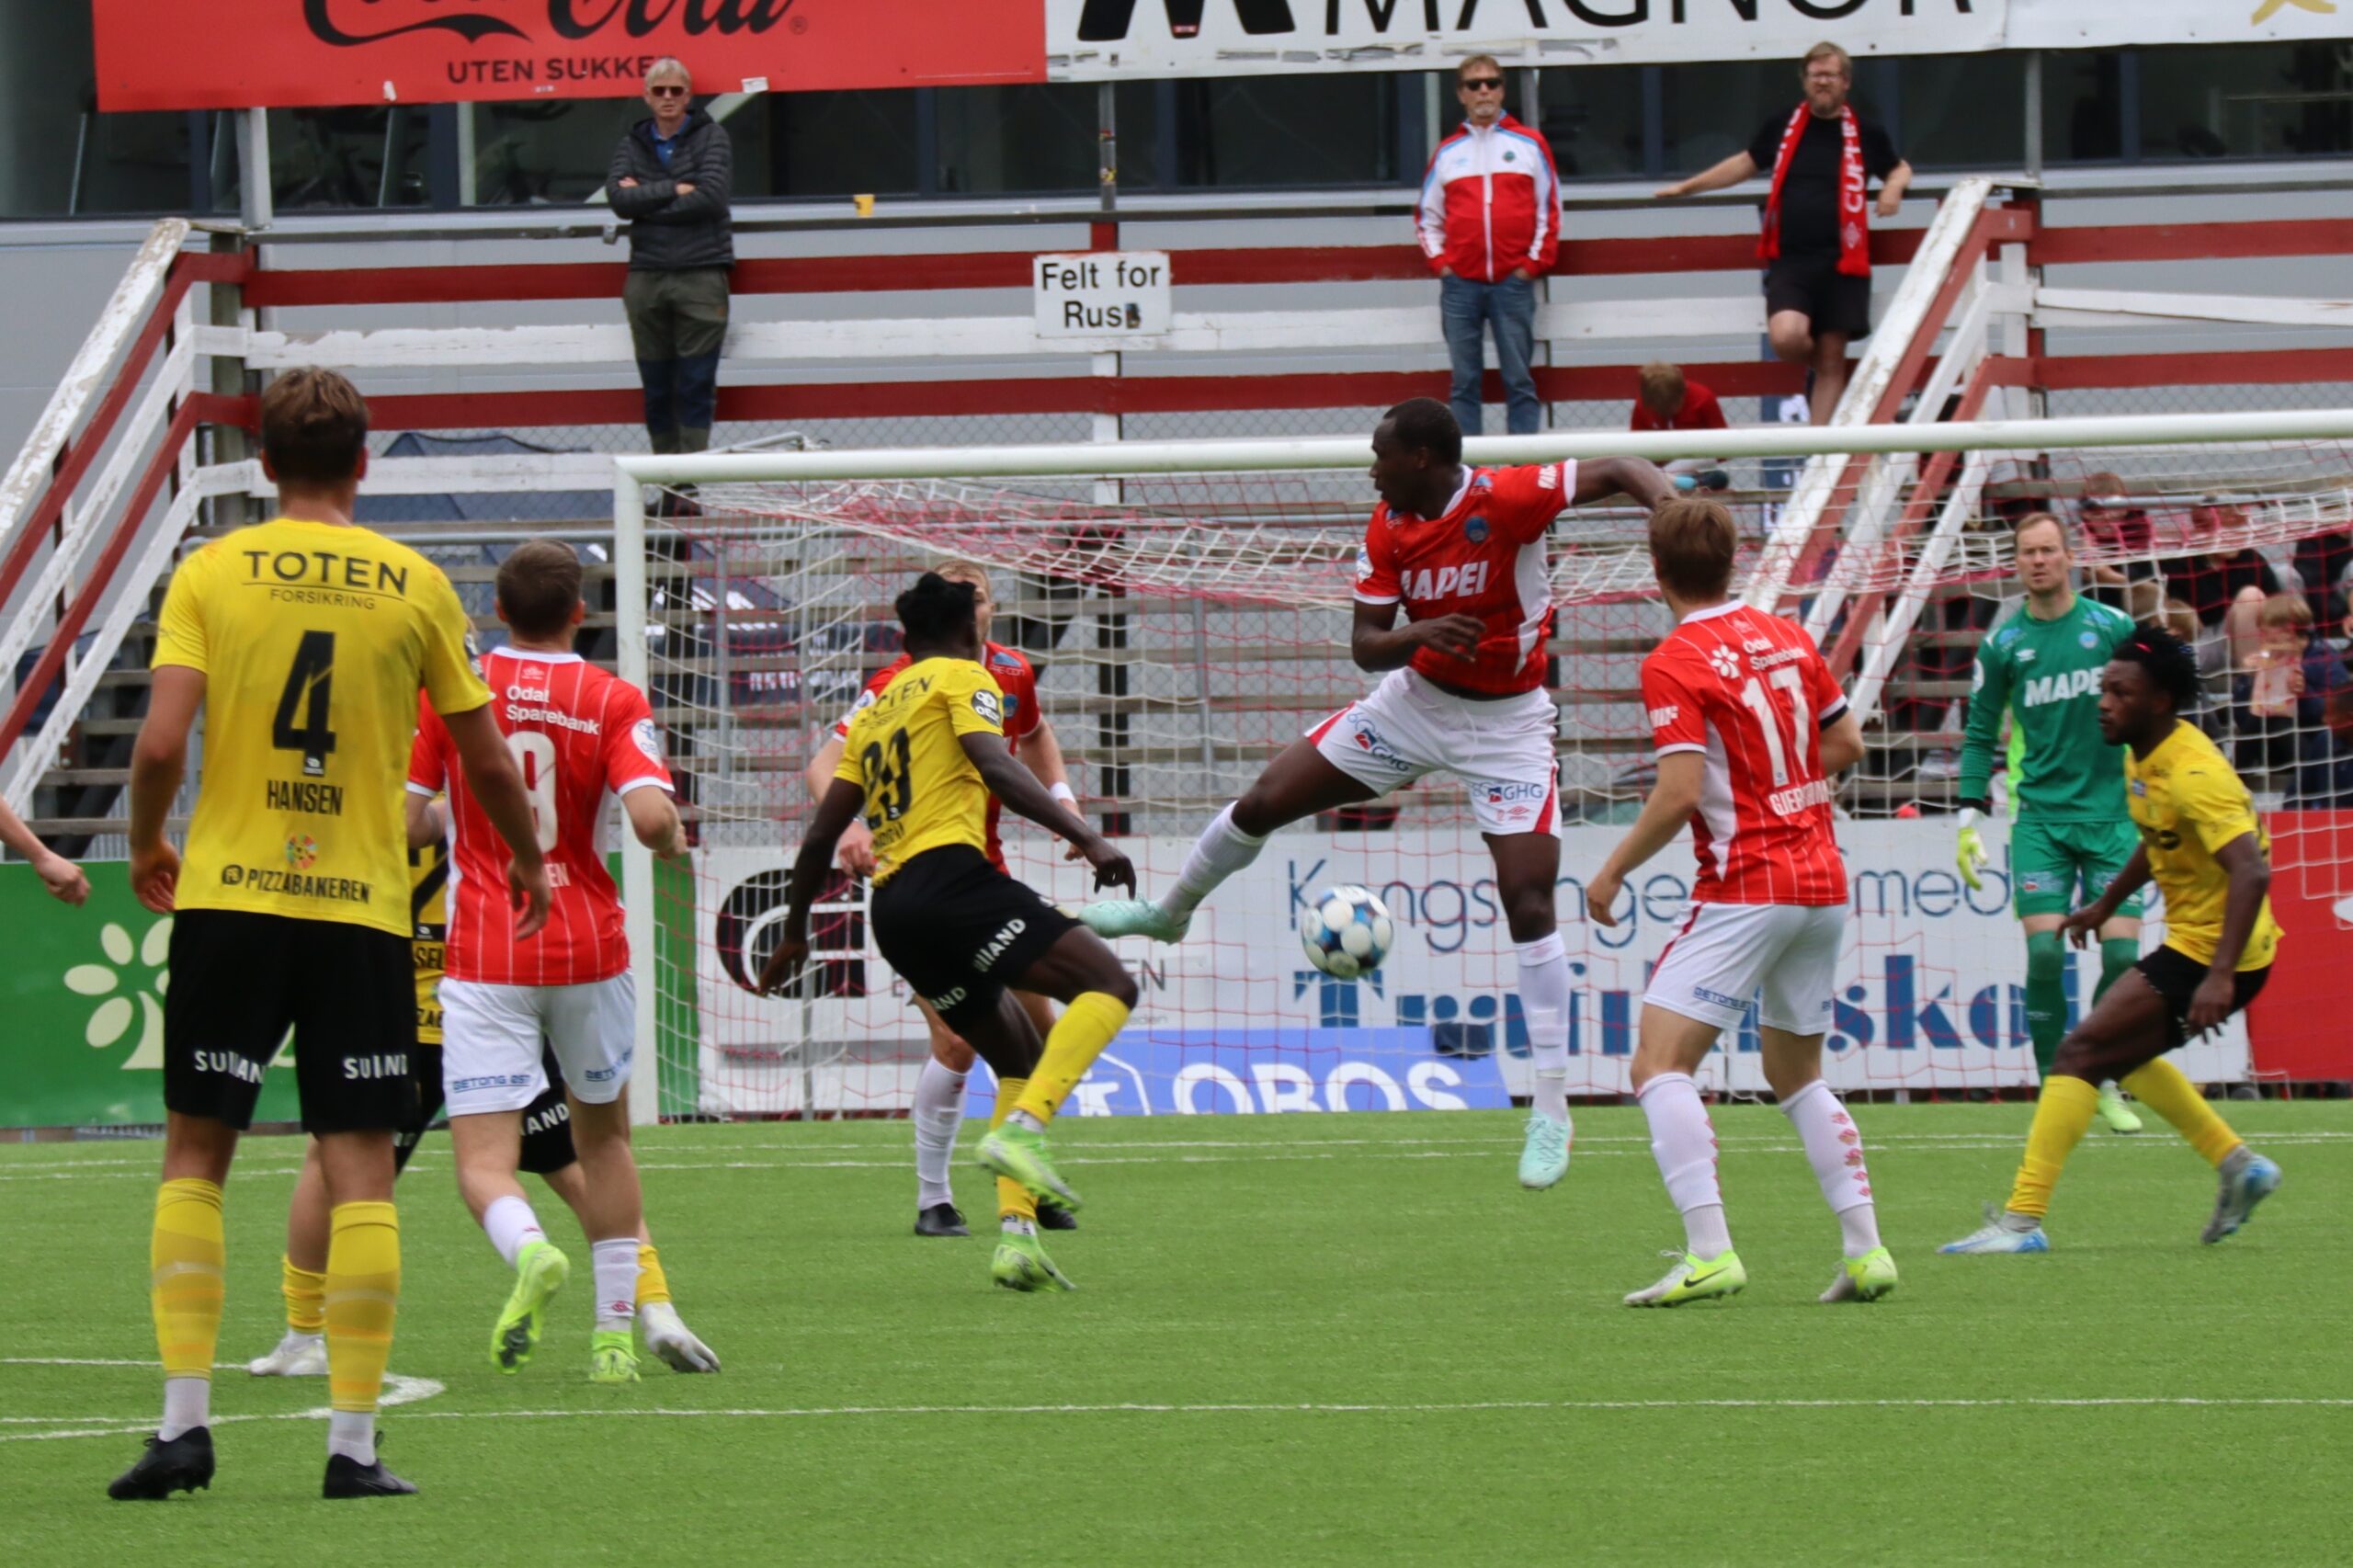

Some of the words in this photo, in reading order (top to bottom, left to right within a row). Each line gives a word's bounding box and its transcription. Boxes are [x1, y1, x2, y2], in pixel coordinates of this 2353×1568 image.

[447, 59, 534, 84] UTEN
[546, 55, 678, 80] SUKKE
[1041, 261, 1099, 290] Felt
[1116, 260, 1160, 287] for
[1063, 301, 1141, 328] Rus
[242, 551, 407, 597] TOTEN
[270, 587, 376, 610] FORSIKRING
[507, 686, 550, 704] Odal
[2024, 666, 2106, 708] MAPE
[272, 630, 337, 778] 4
[506, 705, 600, 735] Sparebank
[1740, 665, 1811, 789] 17
[267, 779, 343, 816] HANSEN
[1504, 784, 1545, 801] GHG
[246, 869, 371, 904] PIZZABAKEREN
[1289, 859, 1688, 952] Kngsnge
